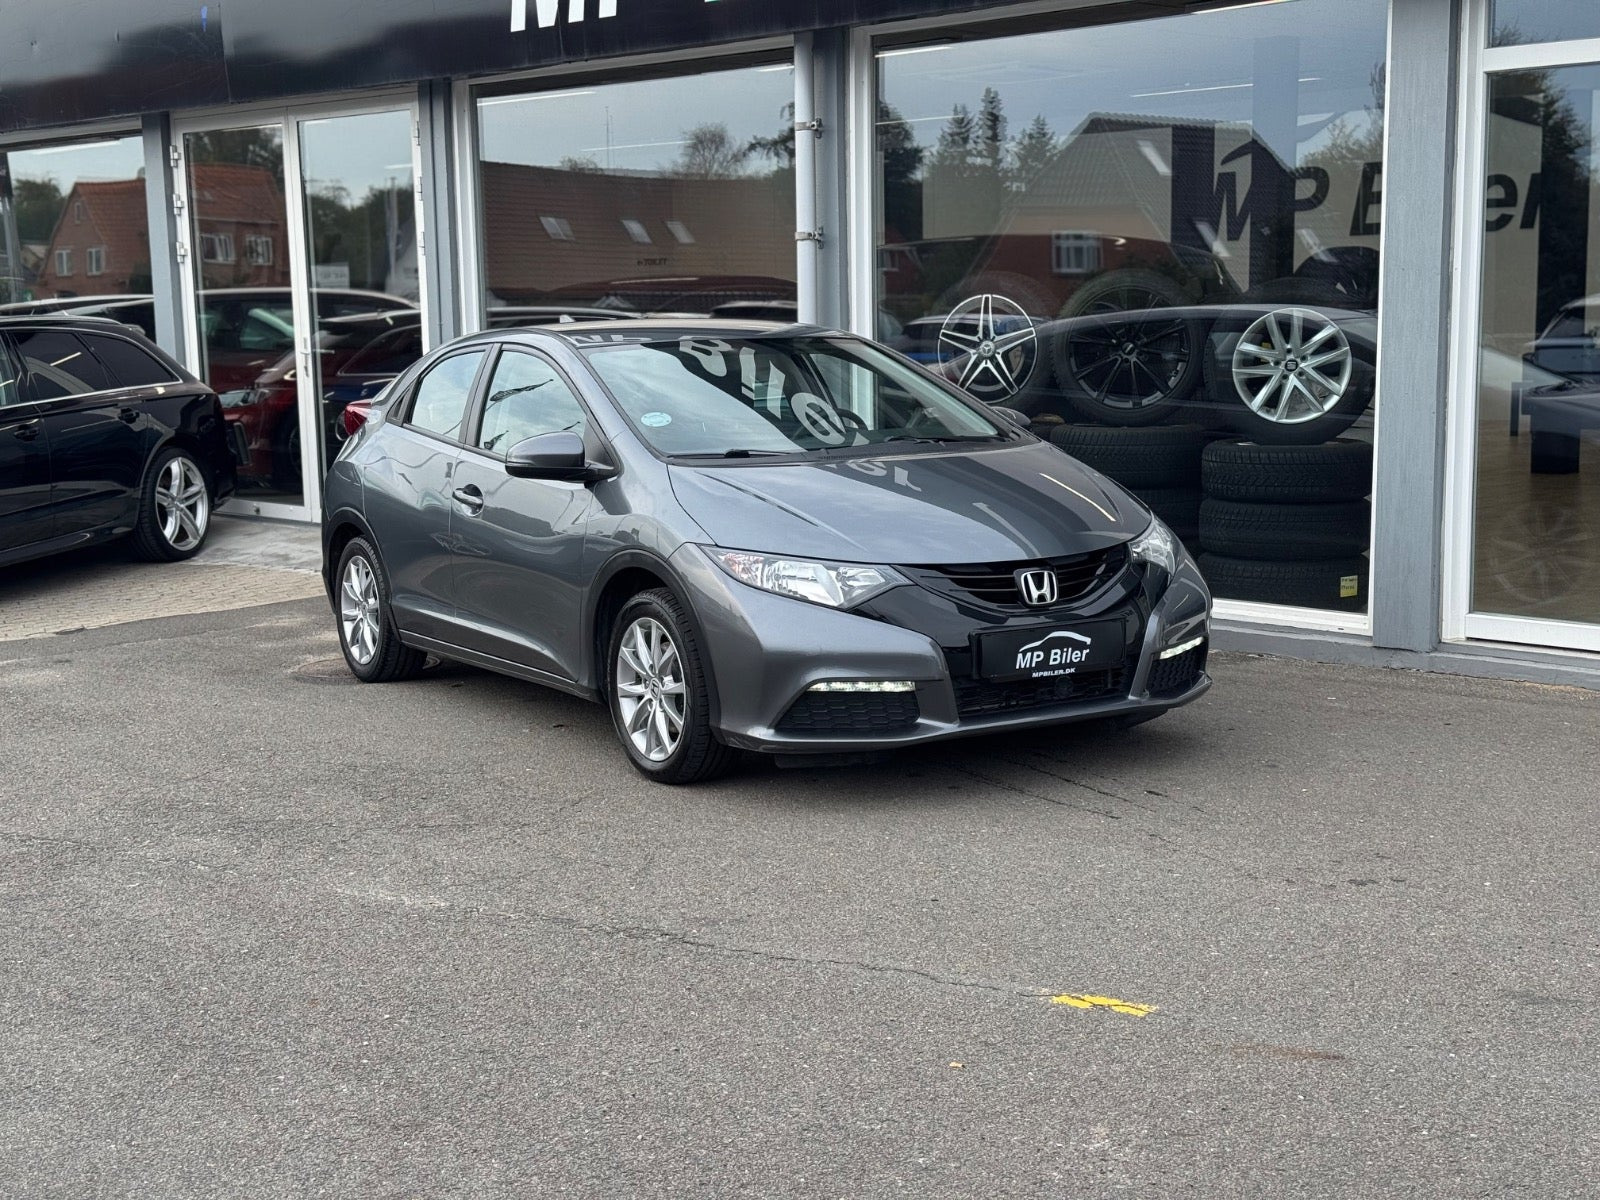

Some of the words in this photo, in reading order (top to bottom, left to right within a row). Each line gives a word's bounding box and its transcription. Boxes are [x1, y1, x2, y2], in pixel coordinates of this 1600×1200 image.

[1015, 650, 1044, 670] MP
[1048, 647, 1090, 666] Biler
[1032, 667, 1076, 678] MPBILER.DK
